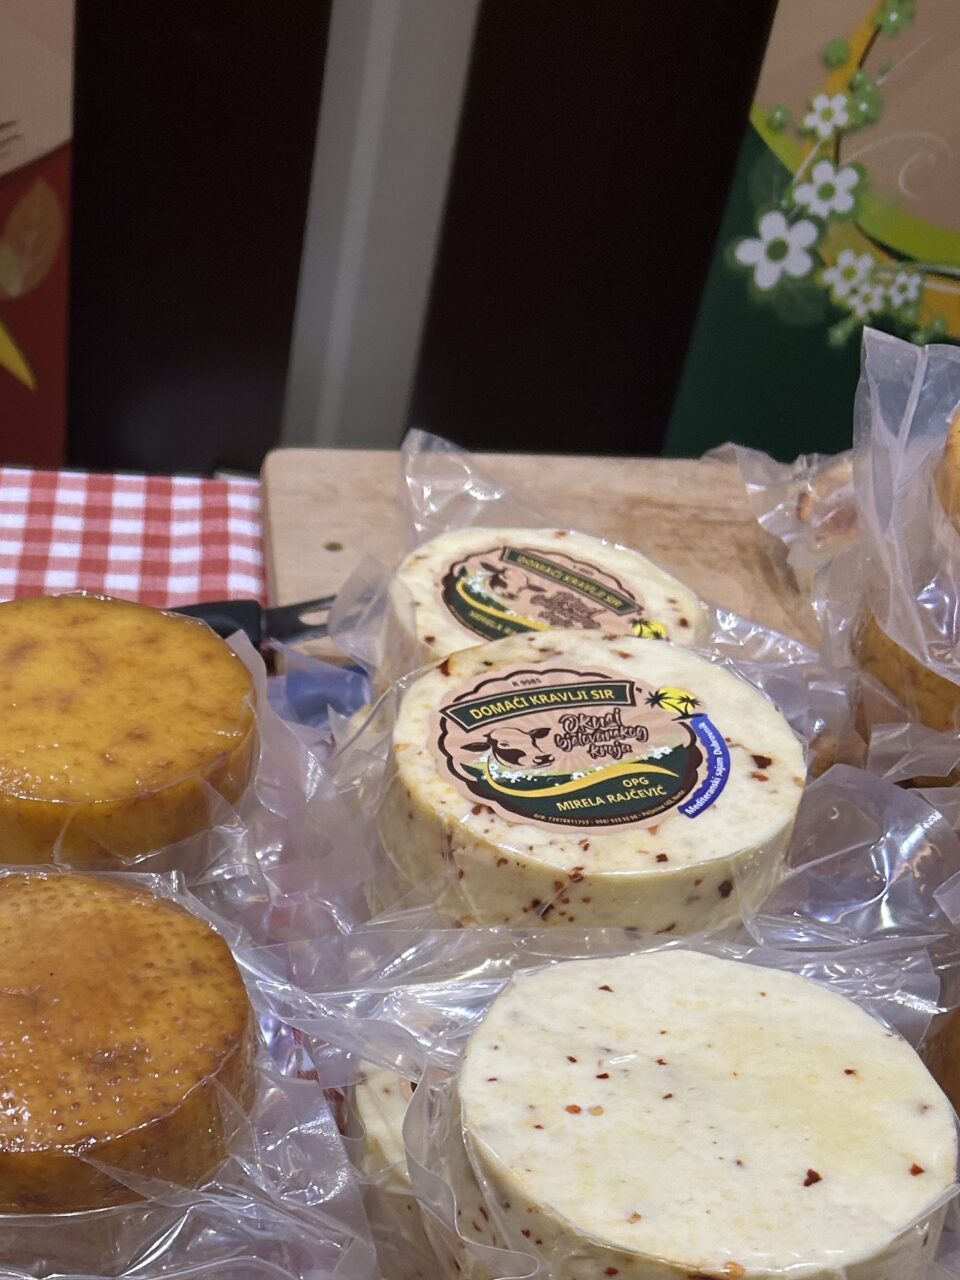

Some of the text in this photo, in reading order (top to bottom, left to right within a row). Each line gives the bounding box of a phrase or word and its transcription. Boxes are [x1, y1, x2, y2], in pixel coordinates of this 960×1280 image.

[469, 688, 616, 720] DOMAĆI KRAVLJI SIR
[622, 776, 650, 788] OPG
[685, 721, 726, 816] Mediteranski sajam Dubrovnik
[556, 785, 667, 812] MIRELA RAJČEVIĆ
